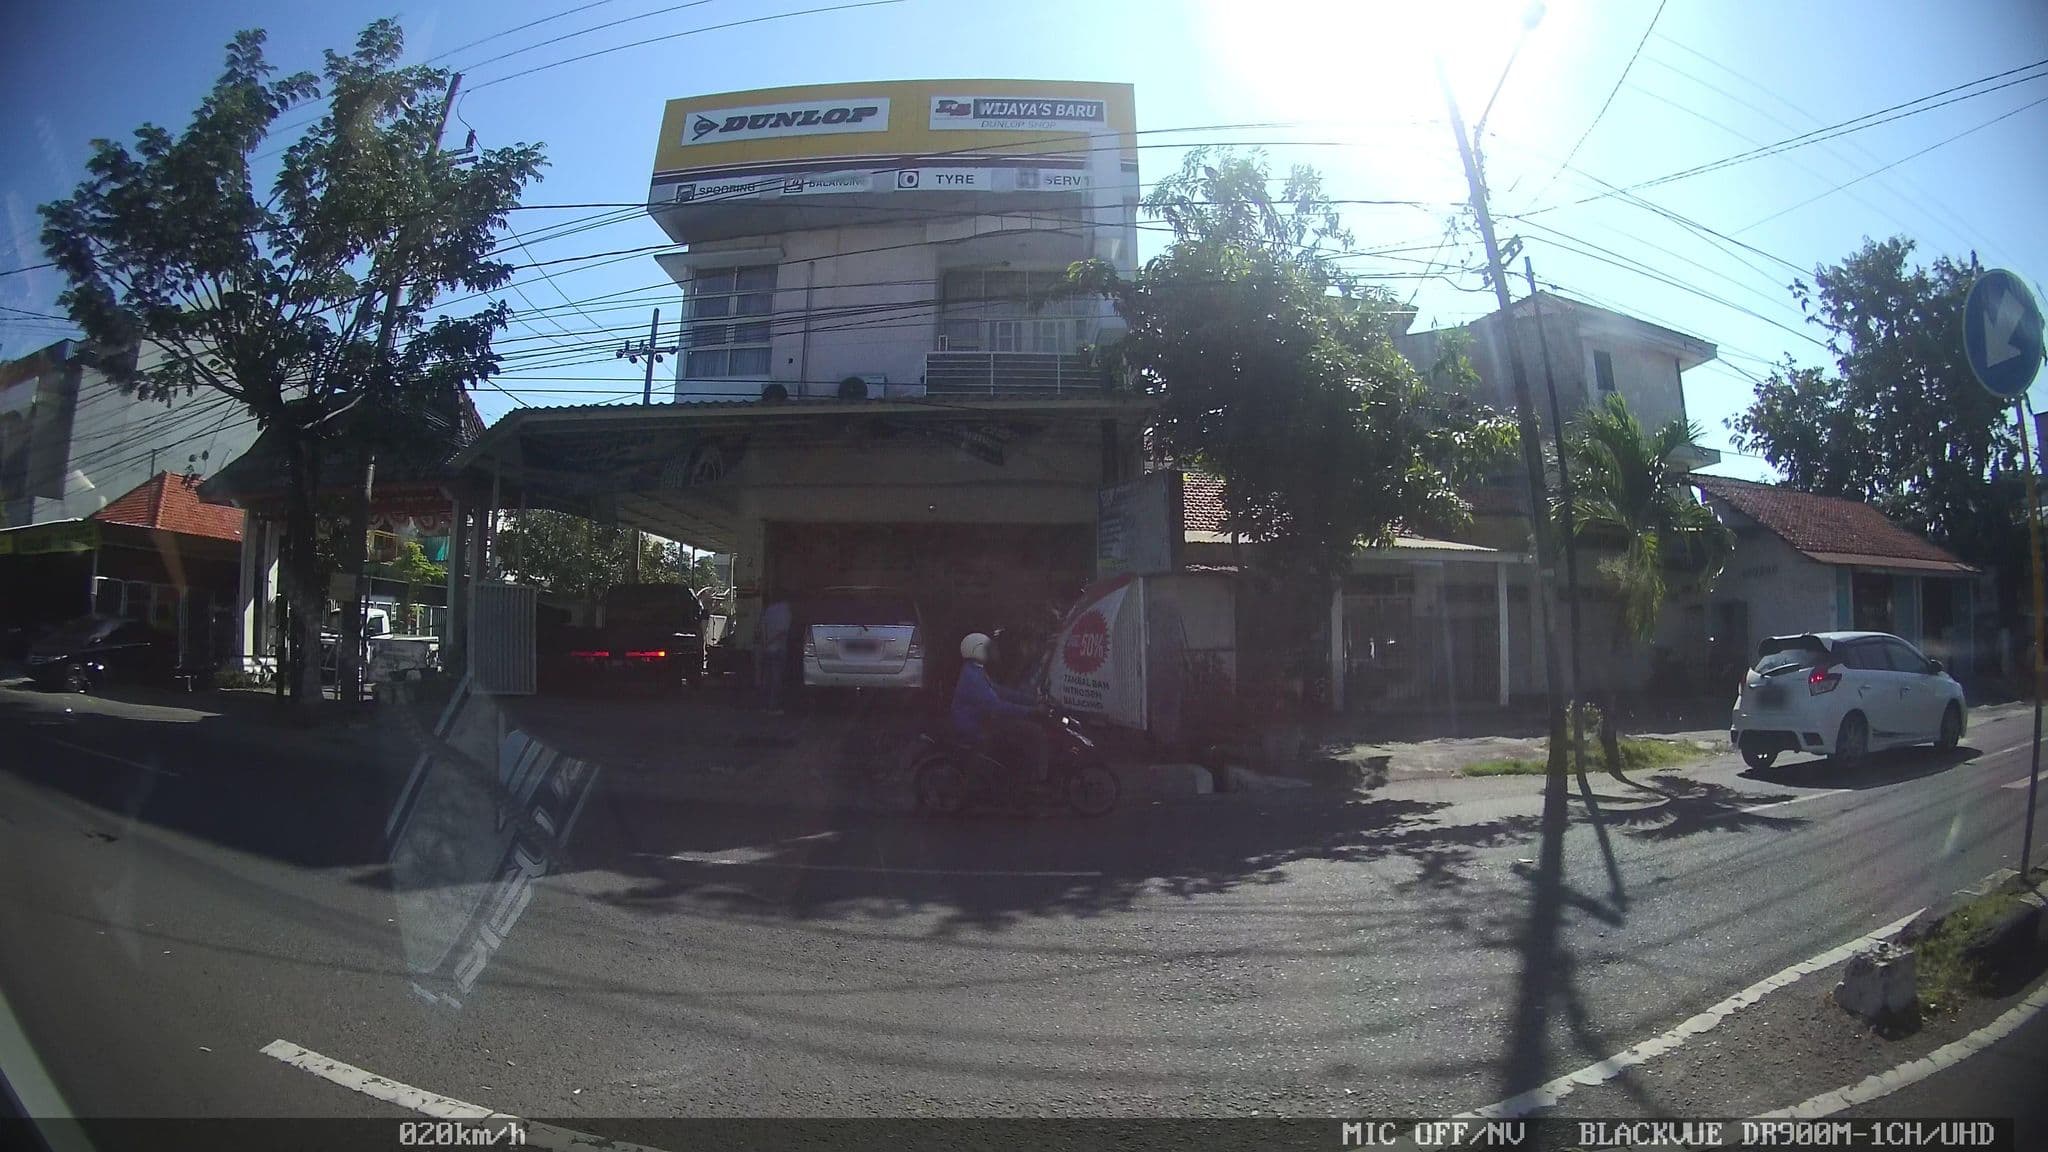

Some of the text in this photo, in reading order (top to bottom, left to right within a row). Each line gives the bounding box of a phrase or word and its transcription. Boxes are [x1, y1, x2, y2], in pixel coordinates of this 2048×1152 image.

[979, 102, 1051, 116] WIJAYA'S
[1055, 104, 1097, 117] BARU
[718, 106, 878, 133] DUNLOP
[981, 120, 1025, 128] DUNLOP
[936, 174, 975, 185] TYRE
